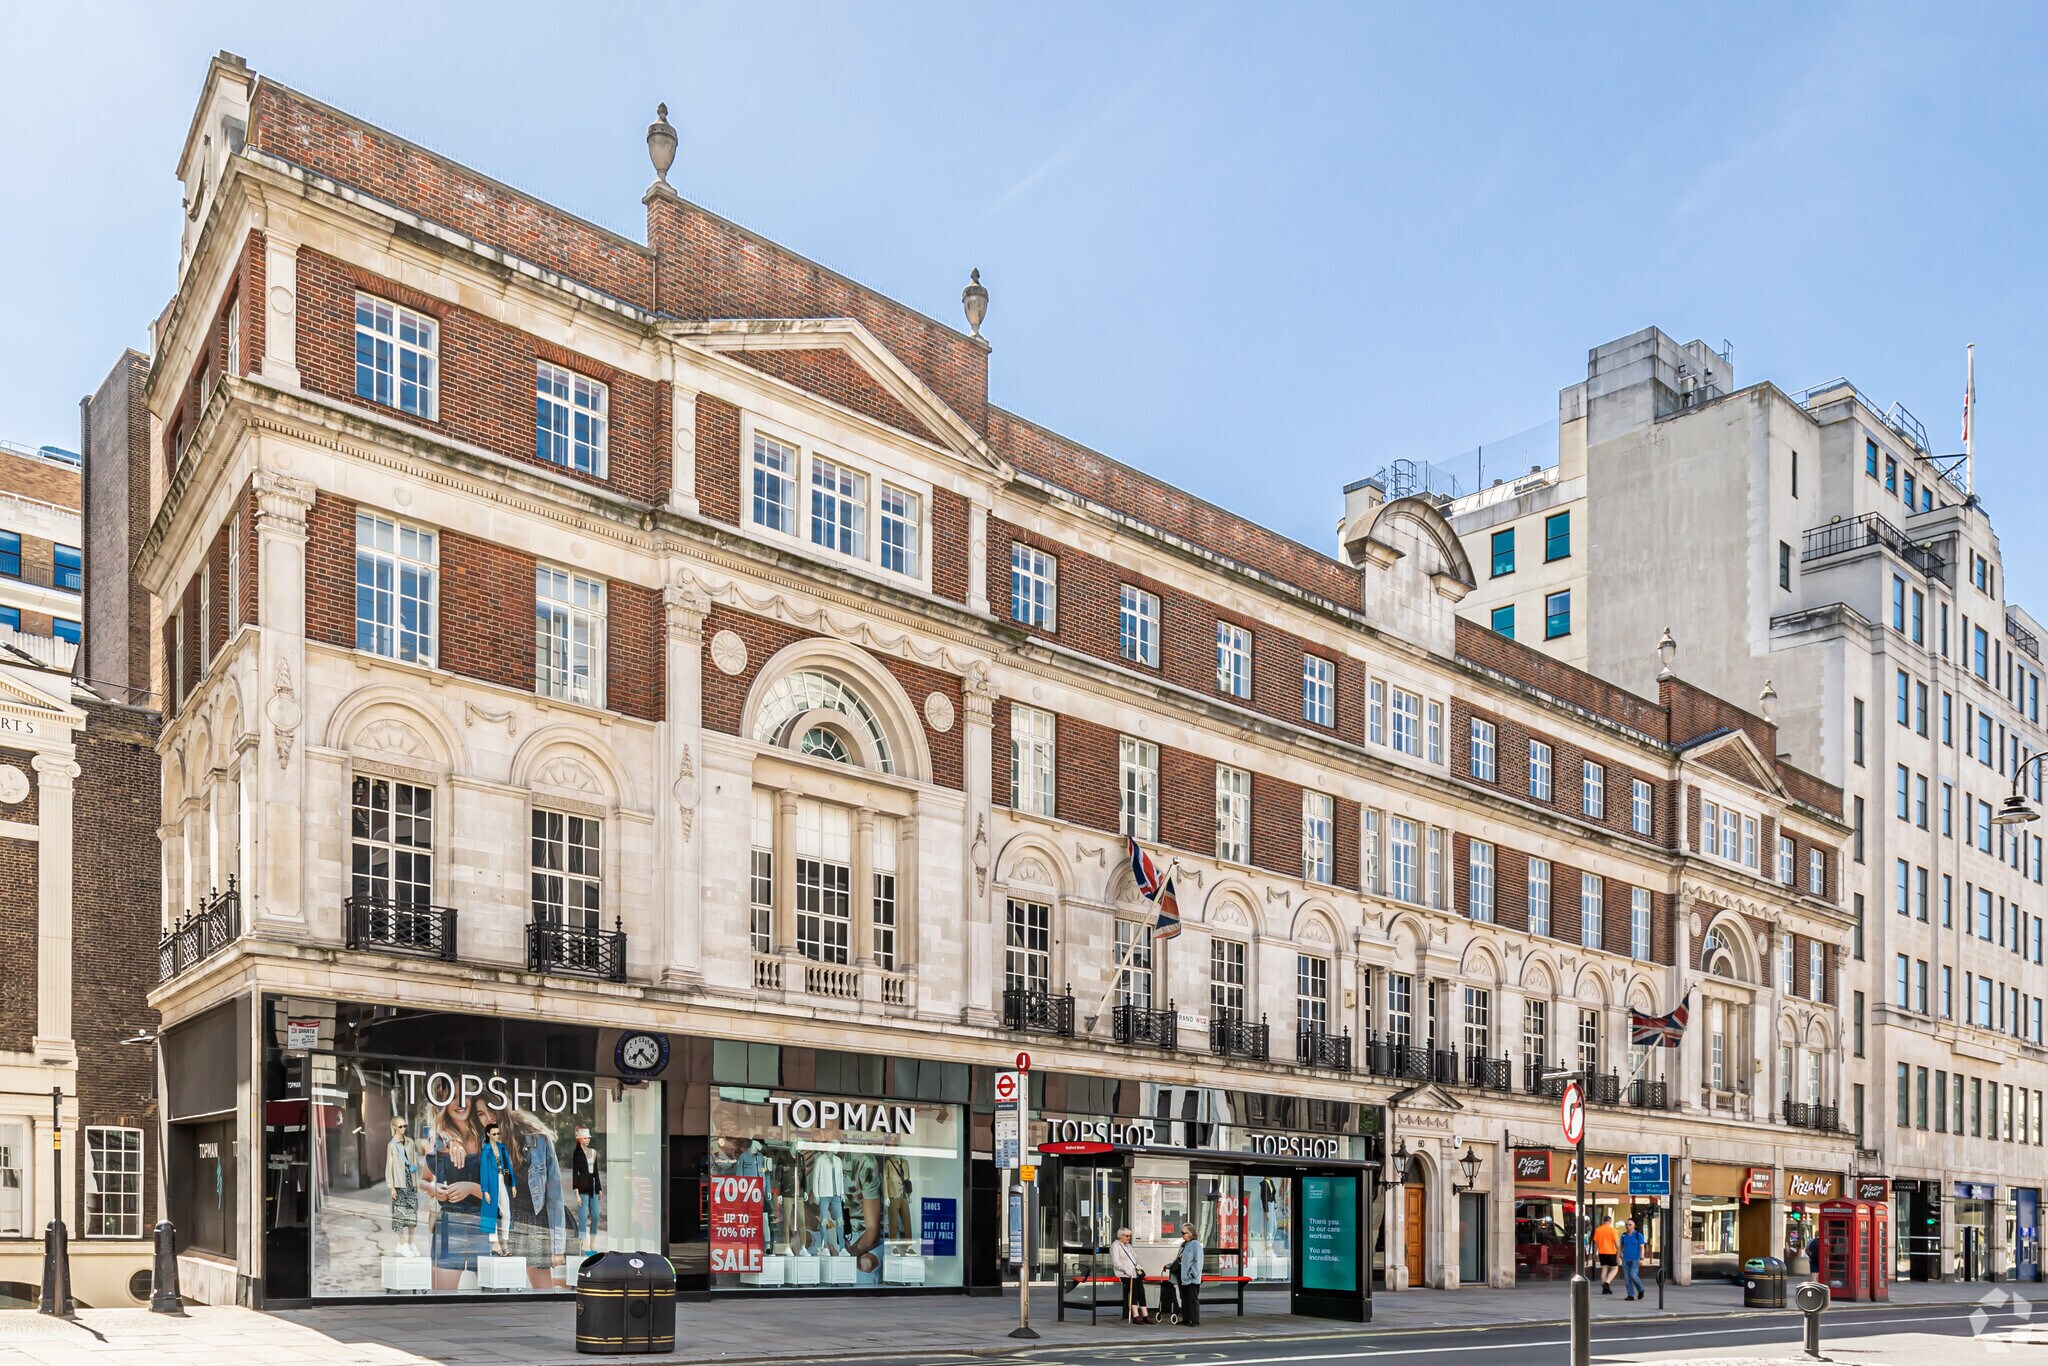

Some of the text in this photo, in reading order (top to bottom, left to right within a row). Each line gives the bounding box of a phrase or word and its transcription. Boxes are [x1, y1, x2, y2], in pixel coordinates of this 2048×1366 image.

[1, 717, 34, 734] RTS
[1178, 1014, 1207, 1025] RAND WC2
[1019, 1054, 1026, 1069] J
[399, 1069, 593, 1115] TOPSHOP
[769, 1097, 916, 1135] TOPMAN
[1047, 1118, 1155, 1146] TOPSHOP
[1251, 1134, 1338, 1159] TOPSHOP
[1418, 1139, 1425, 1148] 60
[199, 1142, 219, 1159] TOPMAN
[1518, 1156, 1545, 1169] Pizza
[1521, 1166, 1543, 1177] Hut
[1566, 1158, 1625, 1185] Pza Hut
[711, 1177, 762, 1204] 70%
[1789, 1174, 1814, 1196] Pizza
[1814, 1176, 1831, 1196] Hut
[1860, 1183, 1884, 1193] Pizza
[1863, 1190, 1882, 1199] Hut
[923, 1201, 941, 1211] SHOES
[723, 1213, 749, 1224] UP TO
[716, 1227, 757, 1238] 70% OFF
[923, 1221, 934, 1230] BUY
[936, 1221, 939, 1230] 1
[940, 1221, 950, 1231] GET
[923, 1231, 954, 1240] HALF PRICE
[711, 1248, 762, 1272] SALE
[1806, 1290, 1813, 1298] 6
